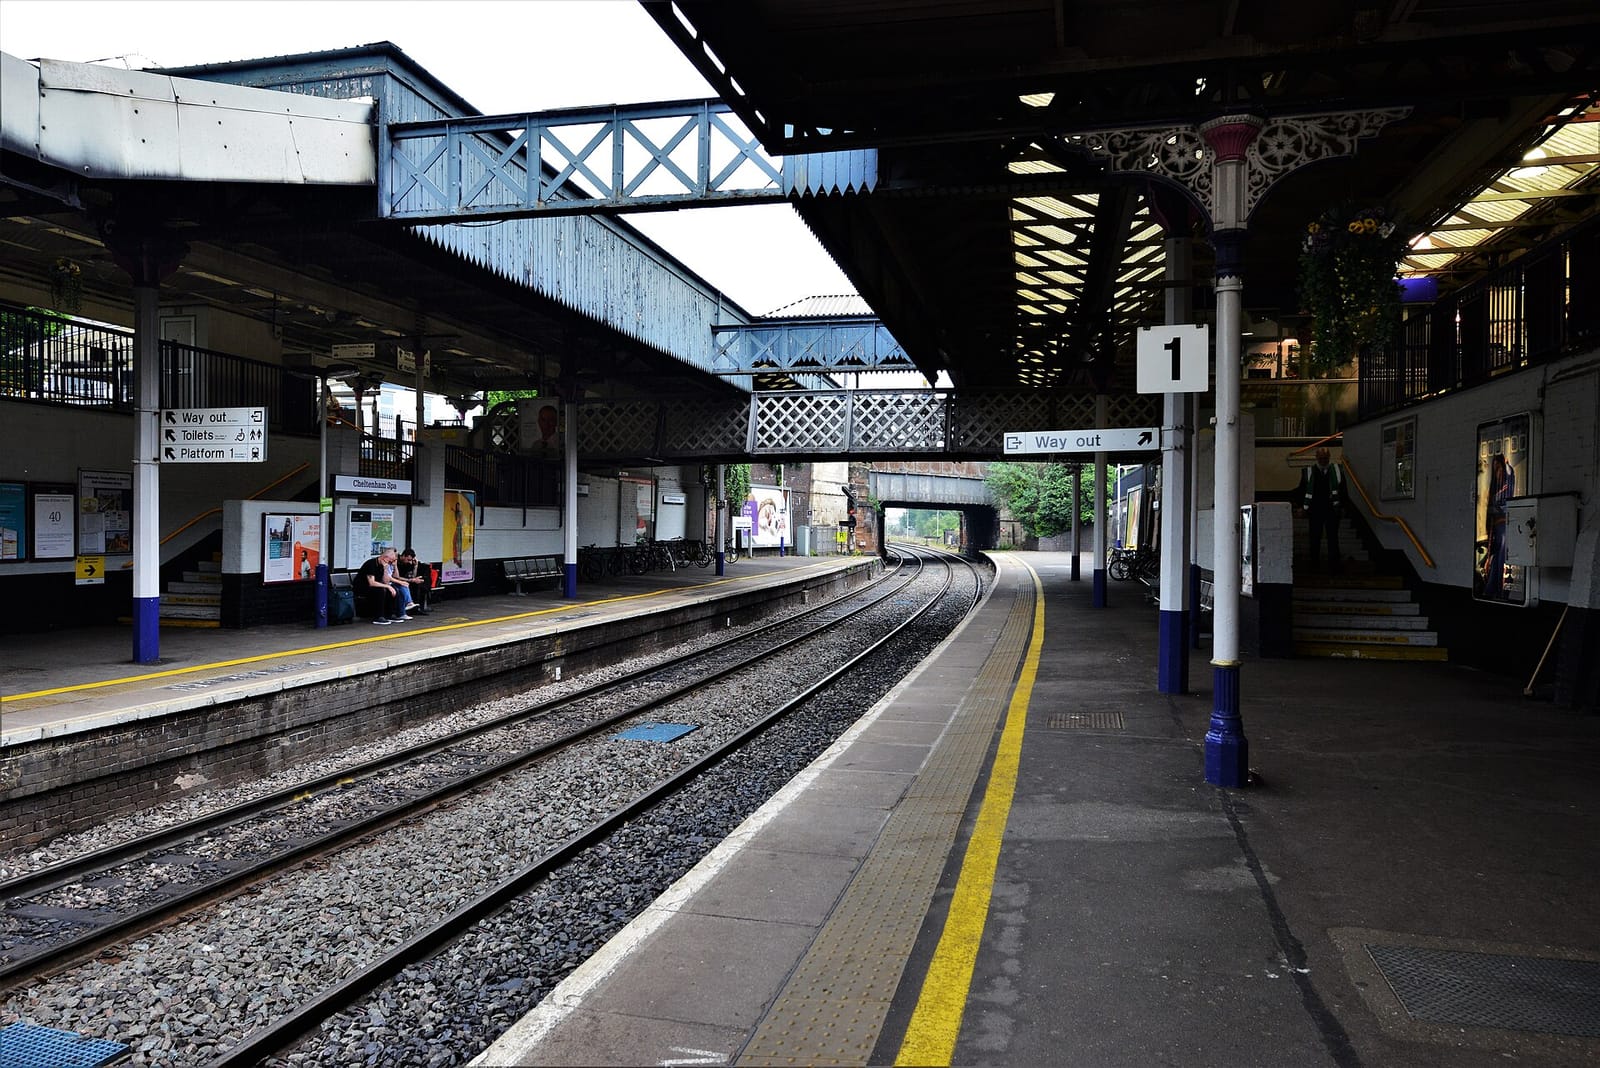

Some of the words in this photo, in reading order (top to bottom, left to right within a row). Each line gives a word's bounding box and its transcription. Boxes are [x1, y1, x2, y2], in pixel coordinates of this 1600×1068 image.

[1164, 337, 1181, 381] 1
[182, 413, 204, 425] Way
[209, 412, 227, 423] out
[181, 430, 214, 441] Toilets
[1035, 436, 1068, 450] Way
[1076, 434, 1102, 447] out
[180, 448, 225, 459] Platform
[353, 479, 386, 490] Cheltenham
[387, 481, 397, 491] Spa
[49, 511, 62, 522] 40
